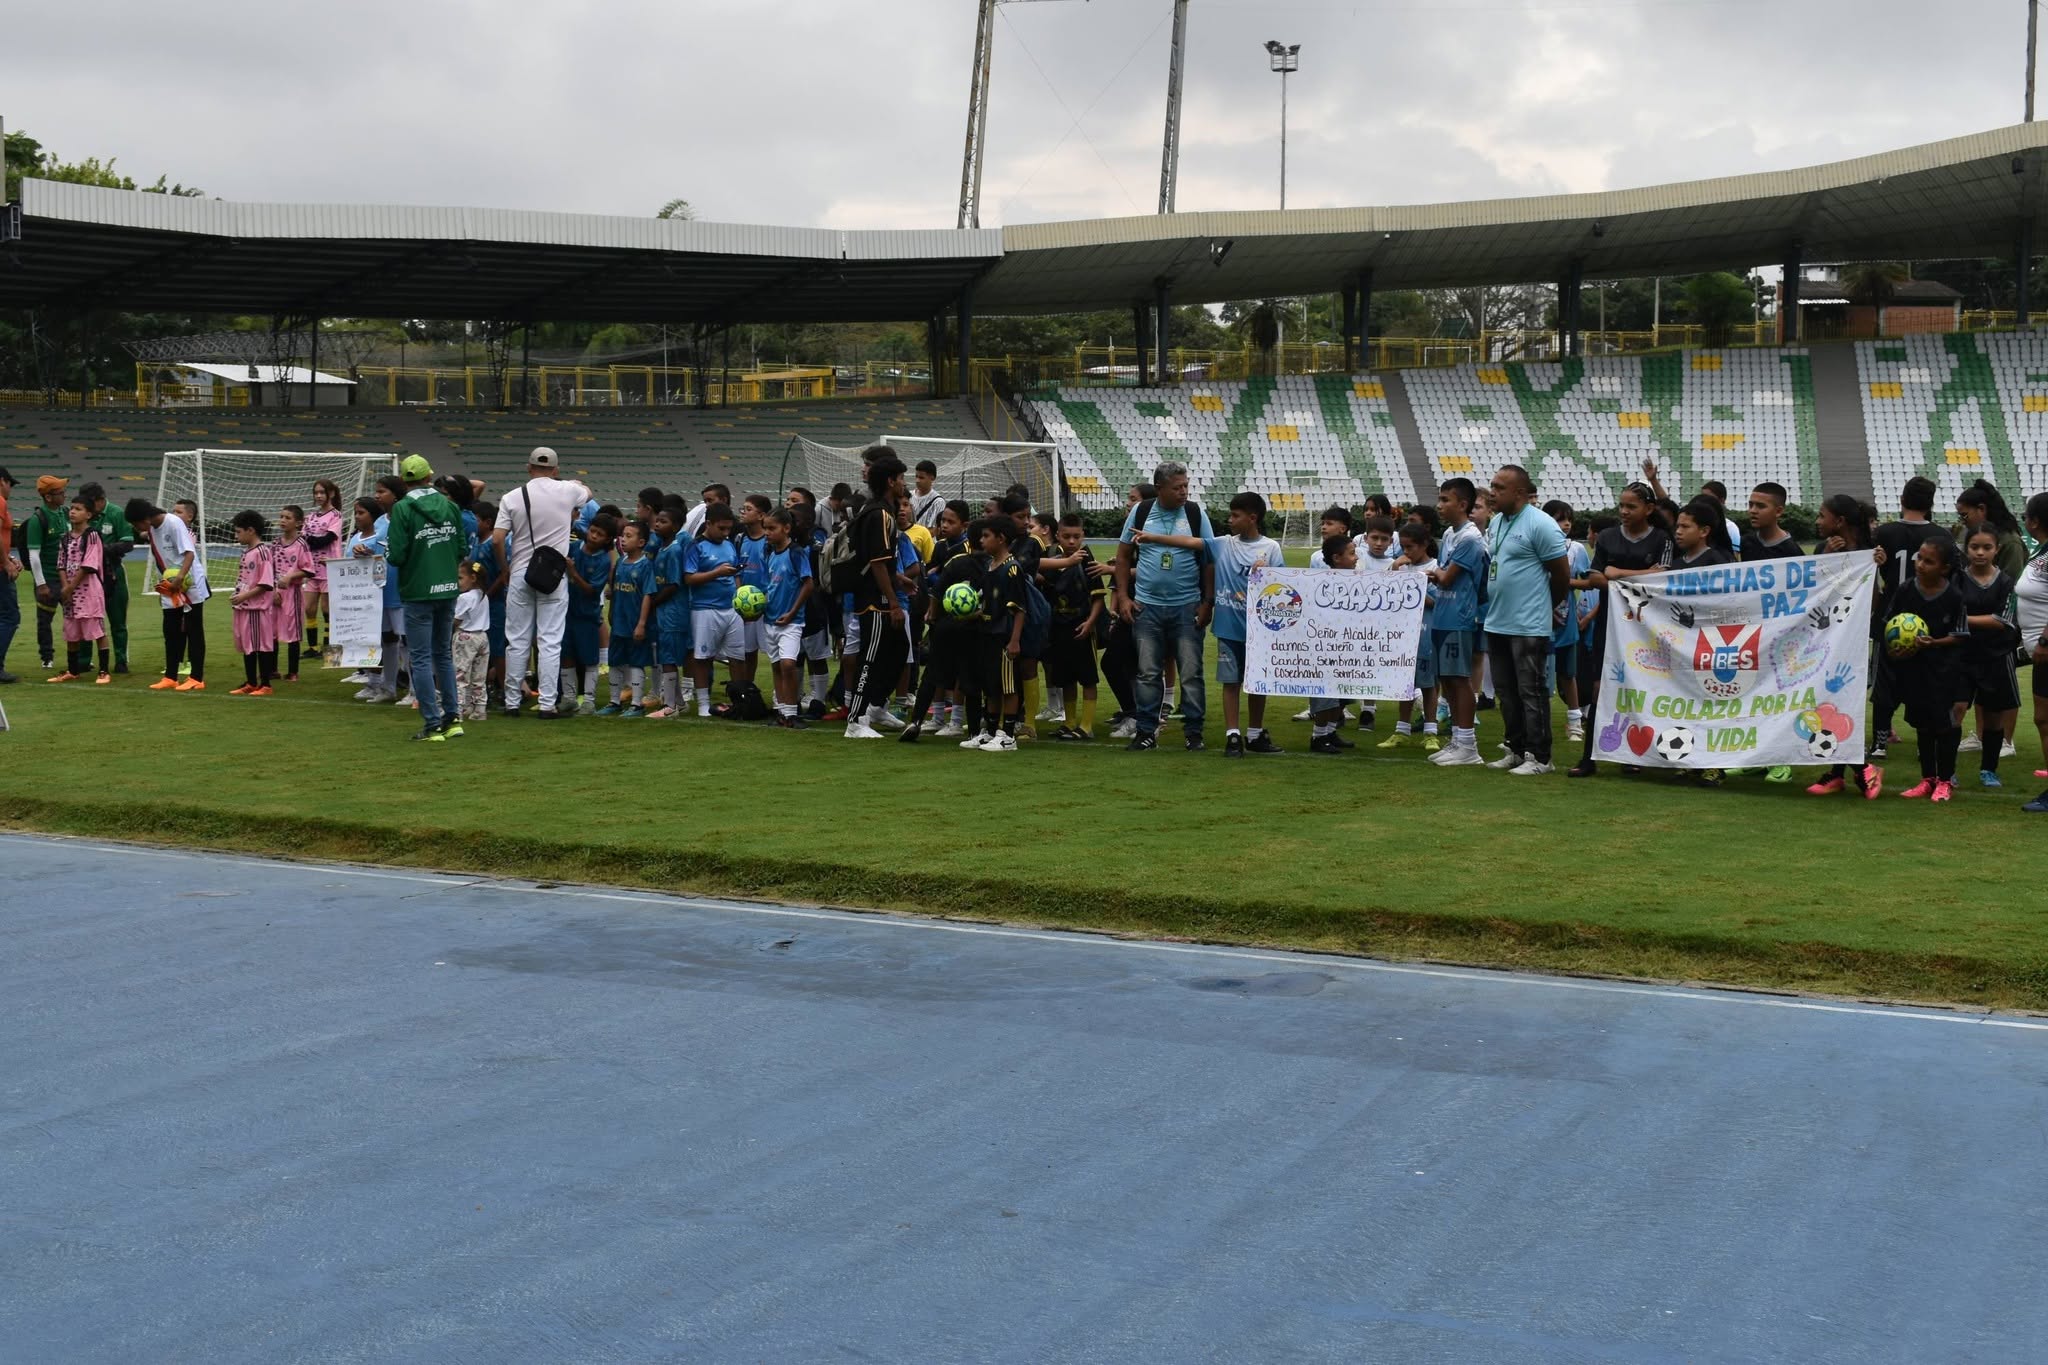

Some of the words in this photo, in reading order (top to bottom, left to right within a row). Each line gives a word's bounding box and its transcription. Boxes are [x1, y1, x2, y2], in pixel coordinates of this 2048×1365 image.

[1665, 565, 1775, 596] HINCHAS
[1786, 560, 1817, 589] DE
[1761, 589, 1809, 619] PAZ
[1306, 618, 1338, 638] Señor
[1386, 630, 1404, 645] por
[1314, 639, 1323, 652] el
[1360, 640, 1374, 652] de
[1378, 640, 1392, 652] la
[1700, 649, 1754, 671] PIBES
[856, 664, 869, 692] adidas
[1273, 680, 1326, 696] FOUNDATION
[1337, 683, 1383, 696] PRESENTE
[1615, 687, 1647, 714] UN
[1651, 695, 1743, 720] GOLAZO
[1750, 693, 1786, 717] POR
[1788, 686, 1817, 712] LA
[1706, 727, 1758, 753] VIDA
